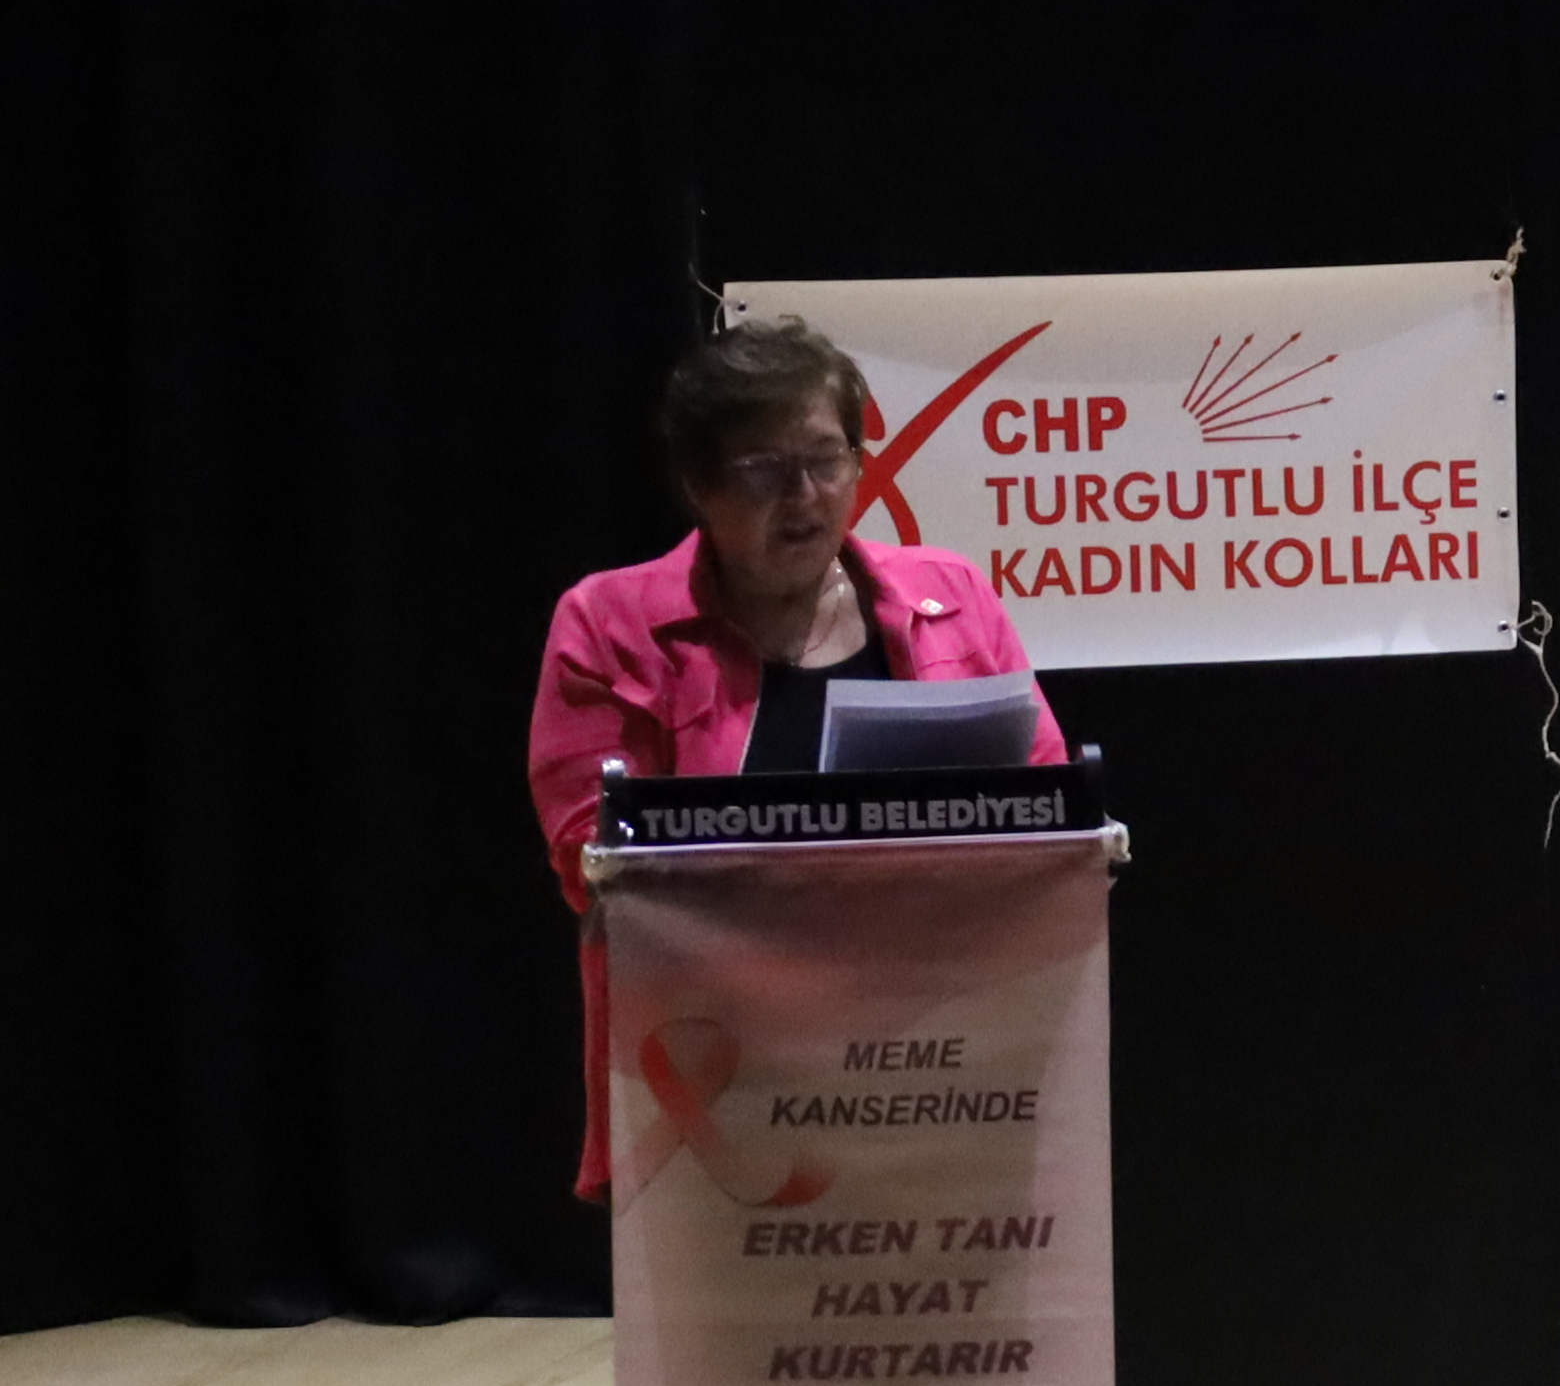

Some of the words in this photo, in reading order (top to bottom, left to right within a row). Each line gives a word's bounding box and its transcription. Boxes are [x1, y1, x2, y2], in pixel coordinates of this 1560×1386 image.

[982, 396, 1128, 455] CHP
[986, 464, 1325, 527] TURGUTLU
[1352, 449, 1479, 526] İLÇE
[990, 541, 1196, 598] KADIN
[1222, 530, 1480, 591] KOLLARI
[642, 804, 846, 840] TURGUTLU
[860, 788, 1066, 831] BELEDİYESİ
[844, 1038, 965, 1071] MEME
[769, 1086, 1039, 1126] KANSERİNDE
[743, 1219, 917, 1256] ERKEN
[935, 1216, 1054, 1249] TANI
[811, 1278, 989, 1318] HAYAT
[768, 1339, 1034, 1381] KURTARIR
